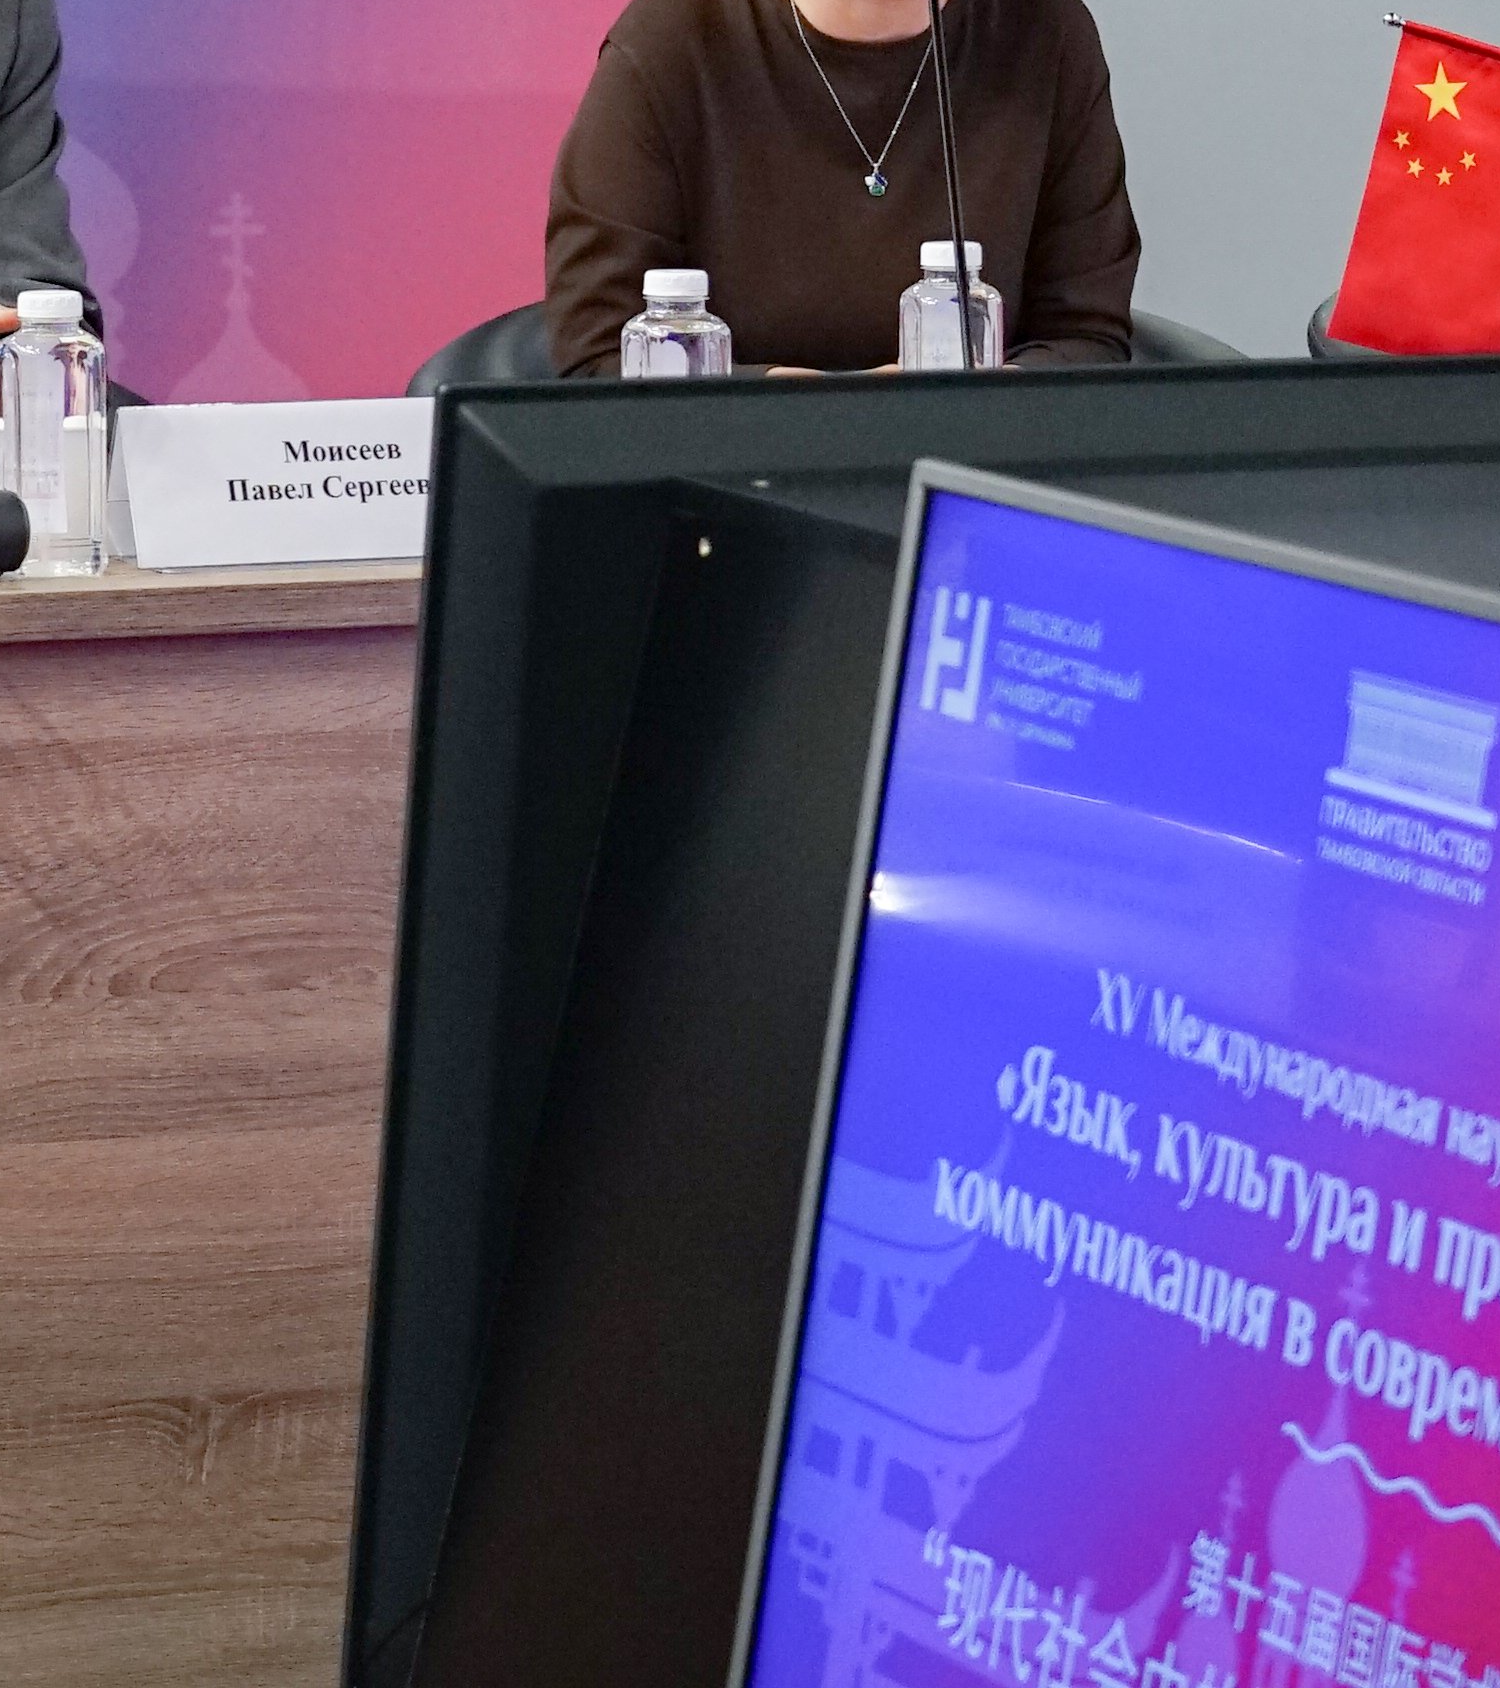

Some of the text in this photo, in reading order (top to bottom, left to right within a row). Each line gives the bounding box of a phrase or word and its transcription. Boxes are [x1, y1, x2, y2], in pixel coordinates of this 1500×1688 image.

[226, 478, 314, 502] Павел
[282, 440, 402, 463] Моисеев
[1090, 968, 1147, 1037] XV
[1147, 987, 1444, 1148] Международная
[934, 1157, 1278, 1351] коммуникация
[1282, 1297, 1318, 1367] в
[1155, 1114, 1380, 1262] культура
[1387, 1199, 1429, 1274] и
